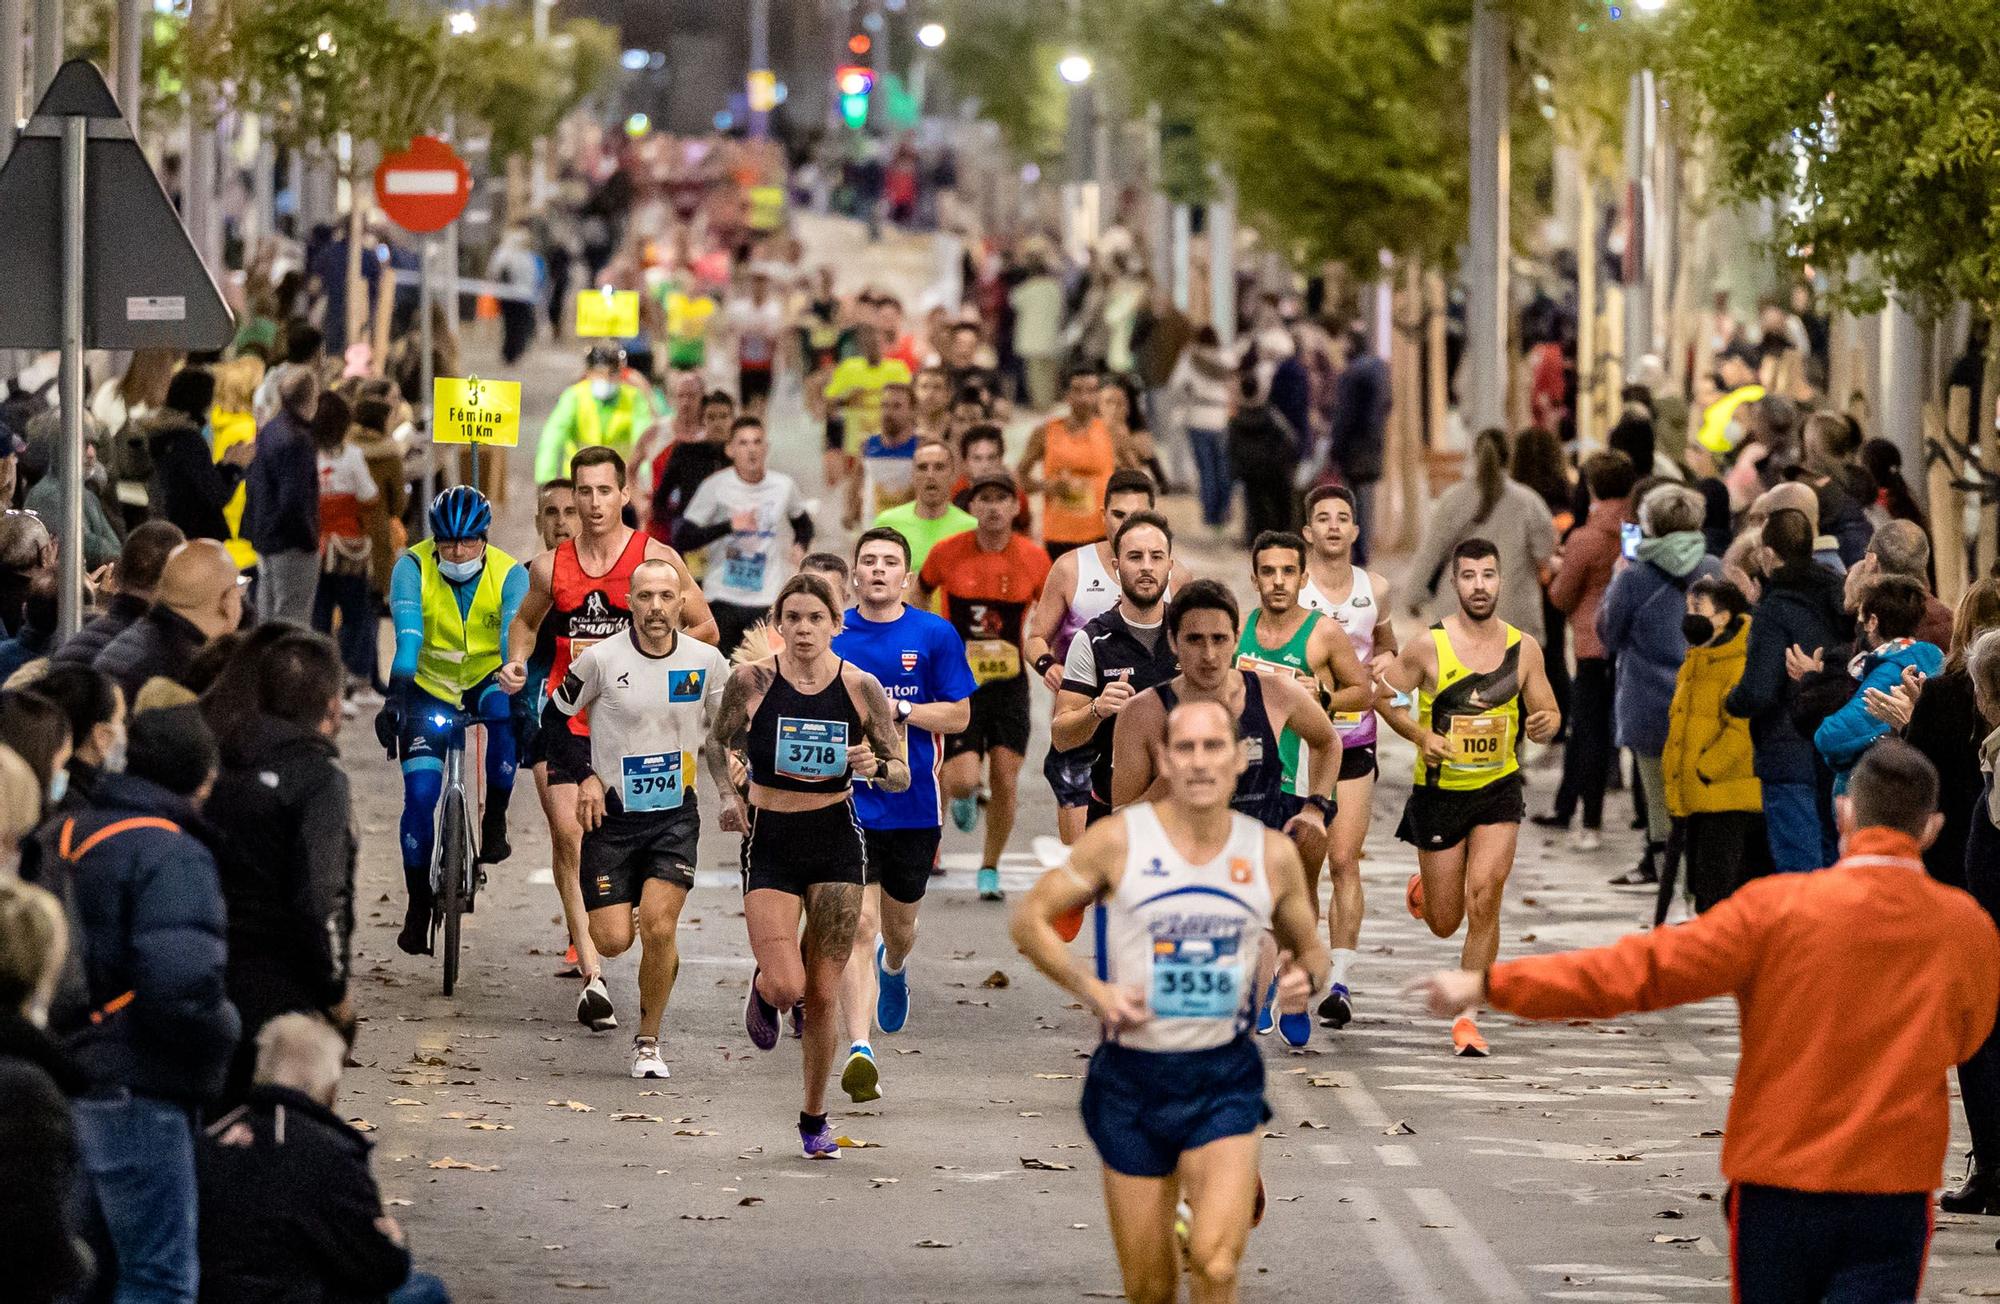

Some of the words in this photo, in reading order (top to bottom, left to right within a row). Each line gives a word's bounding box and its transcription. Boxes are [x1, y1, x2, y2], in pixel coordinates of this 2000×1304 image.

[449, 407, 502, 424] Fémina
[461, 424, 473, 437] 10
[476, 424, 493, 437] Km
[789, 743, 836, 764] 3718
[1462, 738, 1497, 753] 1108
[800, 766, 822, 774] Mary
[631, 775, 676, 795] 3794
